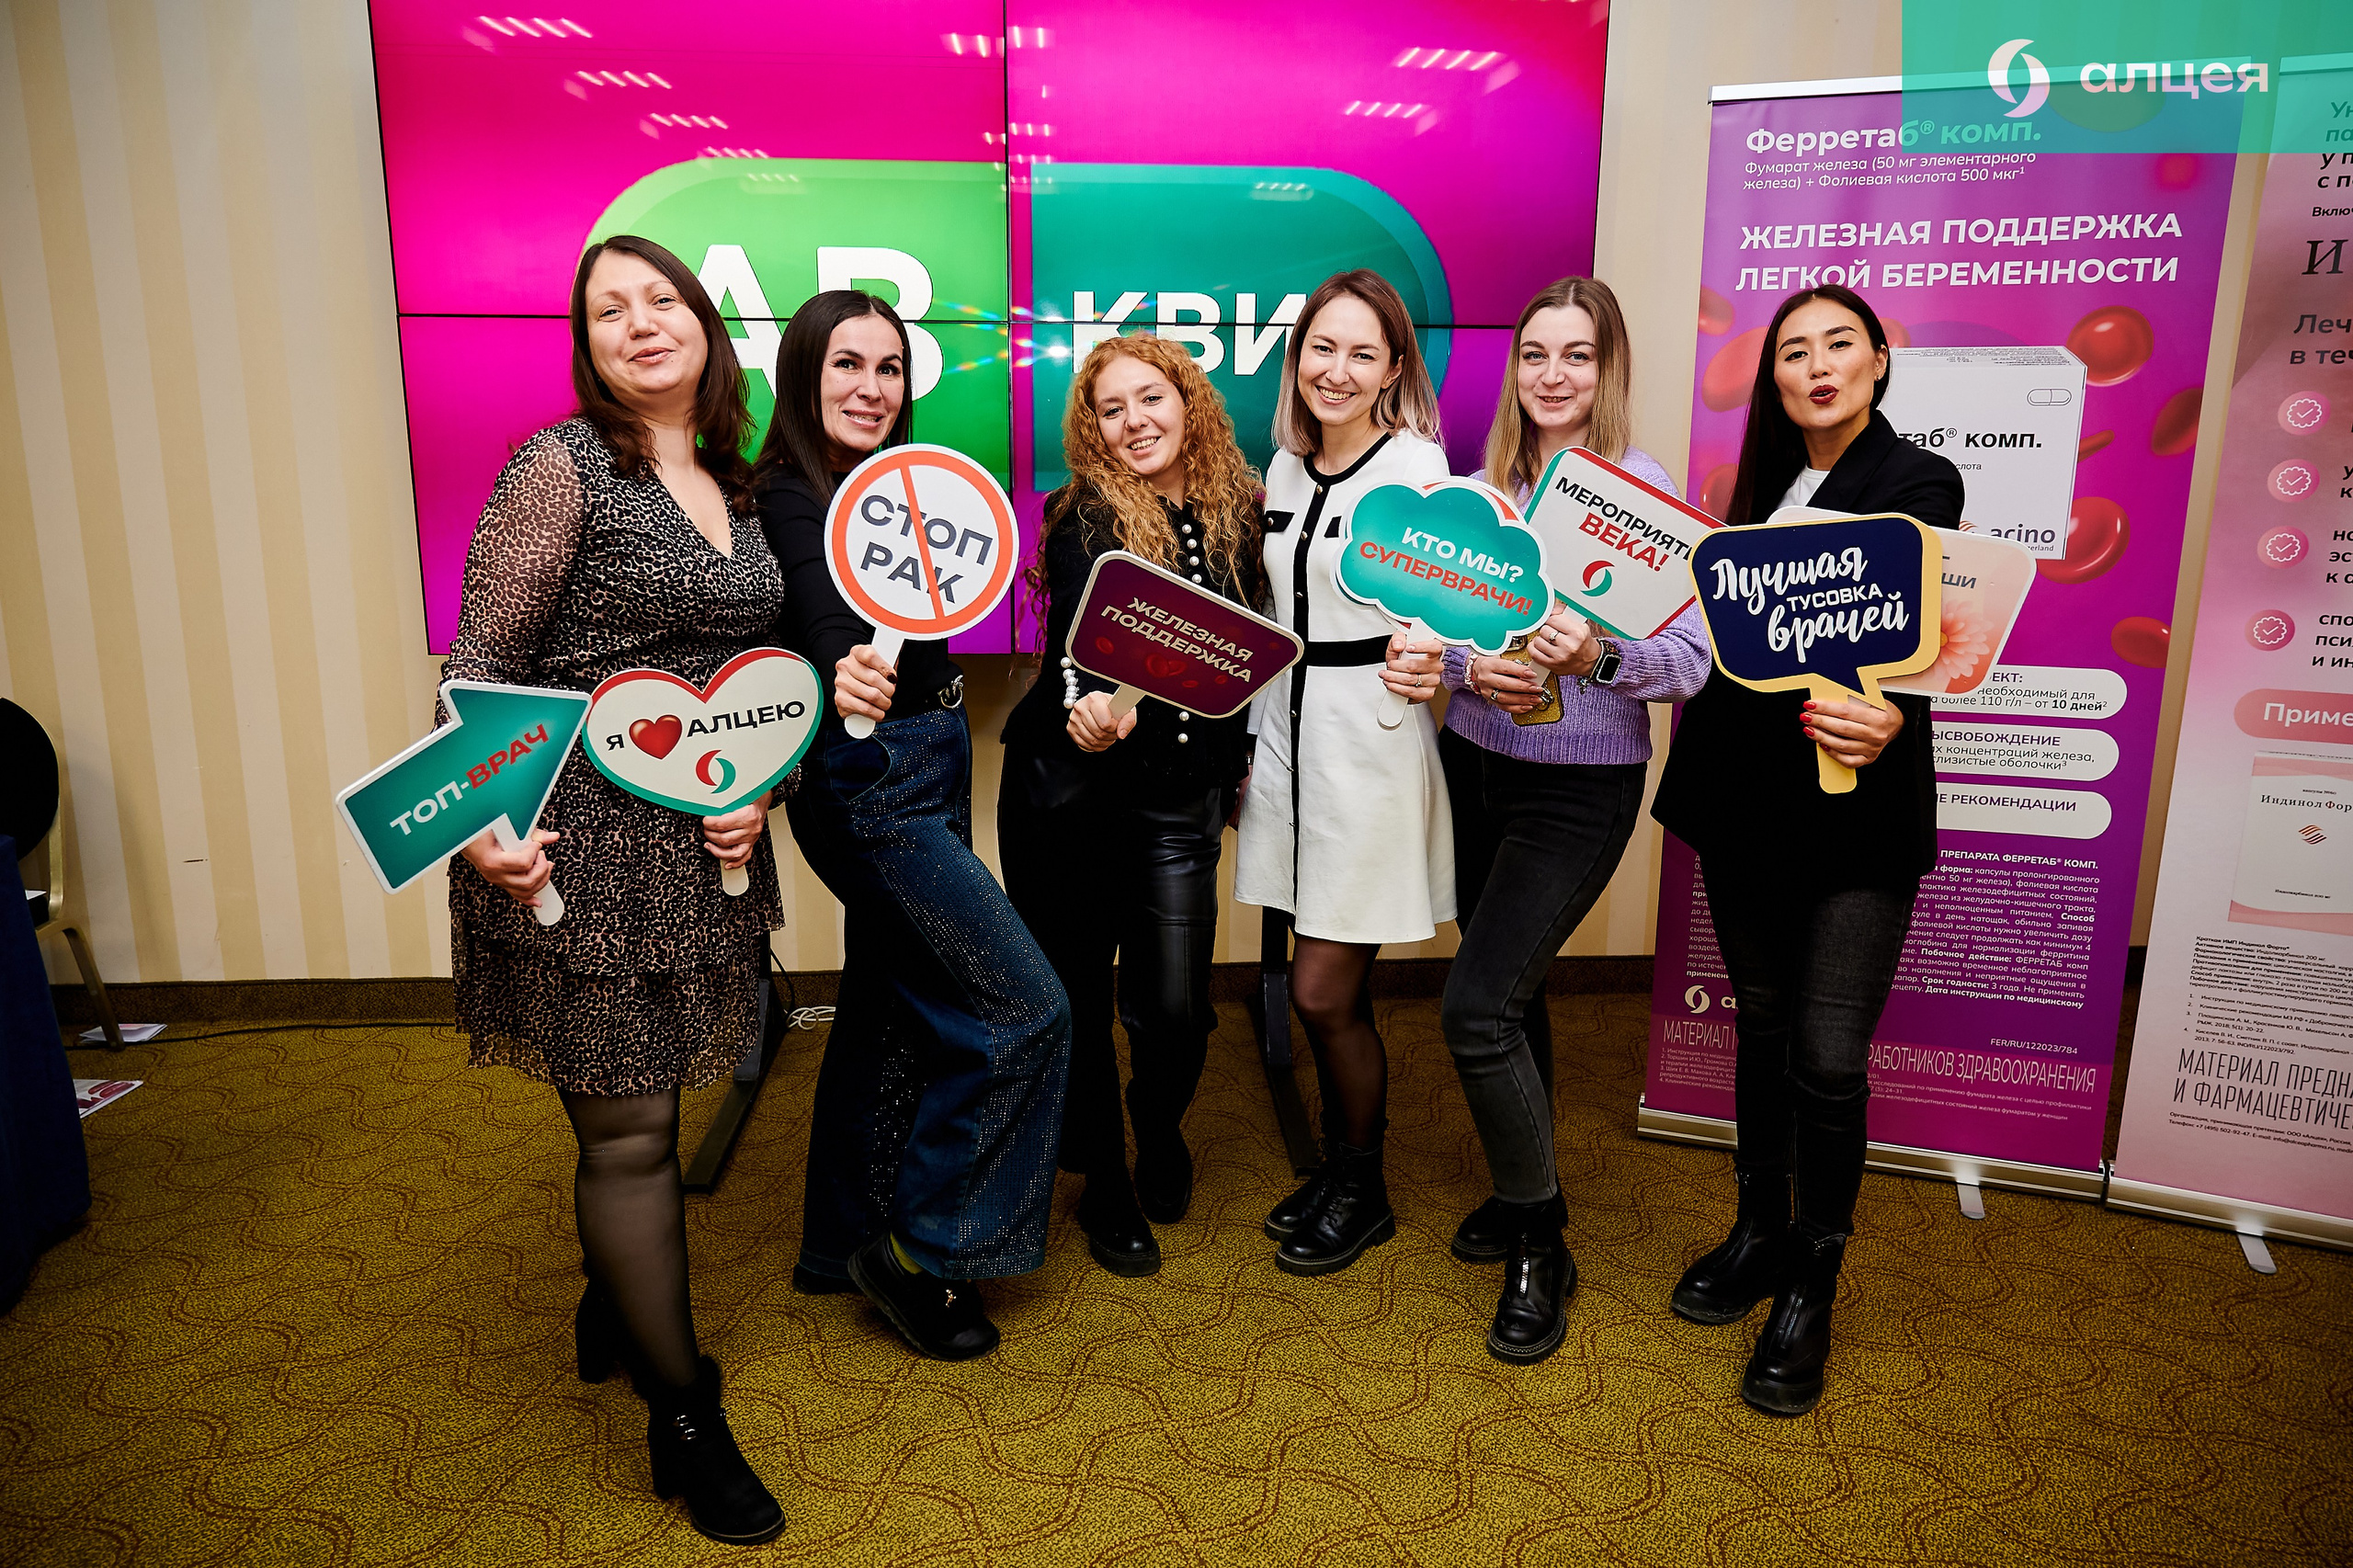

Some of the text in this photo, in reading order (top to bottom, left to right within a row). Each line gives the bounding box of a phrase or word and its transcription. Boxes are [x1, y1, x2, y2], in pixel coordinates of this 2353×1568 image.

[1940, 121, 2041, 144] комп.
[1745, 153, 2036, 175] Фумарат железа (50 мг элементарного
[1743, 176, 1802, 190] железа)
[1819, 174, 1893, 187] Фолиевая
[1896, 171, 1956, 184] кислота
[1961, 168, 1989, 182] 500
[1740, 212, 2183, 250] ЖЕЛЕЗНАЯ ПОДДЕРЖКА
[1734, 256, 2179, 290] ЛЕГКОЙ БЕРЕМЕННОСТИ
[1072, 290, 1307, 376] КВИ
[1964, 433, 2042, 448] комп.
[860, 494, 993, 566] СТОП
[1991, 523, 2056, 543] acino
[1578, 511, 1669, 573] ВЕКА!
[1401, 527, 1525, 584] КТО МЫ?
[860, 540, 964, 604] РАК
[1359, 540, 1534, 617] СУПЕРВРАЧИ!
[1710, 547, 1869, 615] Лучшая
[1786, 584, 1883, 612] ТУСОВКА
[1127, 597, 1254, 663] ЖЕЛЕЗНАЯ
[1768, 591, 1910, 664] врачей
[1101, 605, 1252, 683] ПОДДЕРЖКА
[2315, 635, 2353, 647] пси
[2312, 656, 2325, 666] и
[1991, 672, 2023, 683] ЕКТ:
[1981, 696, 2002, 706] 110
[2005, 697, 2022, 707] г/л
[2052, 699, 2067, 709] 10
[2071, 692, 2096, 700] для
[606, 700, 805, 751] Я АЛЦЕЮ
[1931, 731, 2061, 746] ЫСВОБОЖДЕНИЕ
[1946, 746, 2095, 763] концентраций железа,
[390, 723, 550, 836] ТОП-ВРАЧ
[1951, 794, 2076, 812] РЕКОМЕНДАЦИИ
[2260, 794, 2323, 809] Индинол
[1940, 850, 2000, 861] ПРЕПАРАТА
[2063, 858, 2098, 869] КОМП.
[1940, 864, 2100, 883] форма: капсулы пролонгированного
[1949, 874, 1960, 882] 50
[2016, 880, 2060, 890] фолиевая
[2063, 885, 2098, 893] кислота
[1916, 892, 1949, 901] железа
[1962, 896, 2062, 910] желудочно-кишечного
[1960, 886, 2046, 899] железодефицитных
[1935, 903, 2003, 914] неполноценным
[2061, 912, 2095, 923] Способ
[1911, 919, 2093, 943] фолиевой кислоты нужно увеличить дозу
[2015, 917, 2052, 928] обильно
[2056, 923, 2094, 932] запивая
[1936, 931, 1969, 940] следует
[1971, 934, 2024, 945] продолжать
[2043, 940, 2083, 951] минимум
[1972, 944, 2036, 955] нормализации
[2040, 949, 2090, 960] ферритина
[1917, 959, 2087, 980] возможно временное неблагоприятное
[1921, 948, 2088, 971] Побочное действие: ФЕРРЕТАБ комп
[1912, 967, 1961, 977] наполнения
[1975, 973, 2027, 983] неприятные
[2030, 978, 2076, 988] ощущения
[1922, 975, 1944, 985] Срок
[1946, 979, 1989, 989] годности:
[1999, 983, 2020, 992] года.
[2038, 988, 2085, 999] применять
[1925, 985, 1949, 994] Дата
[1950, 988, 2002, 999] инструкции
[2017, 995, 2084, 1009] медицинскому
[1663, 1019, 1730, 1050] МАТЕРИАЛ
[1990, 1038, 2078, 1054] FER/RU/122023/784
[1956, 1052, 2097, 1094] ЗДРАВООХРАНЕНИЯ
[2177, 1048, 2353, 1098] МАТЕРИАЛ ПРЕДН
[2173, 1077, 2187, 1103] И
[2193, 1081, 2353, 1130] ФАРМАЦЕВТИЧЕ
